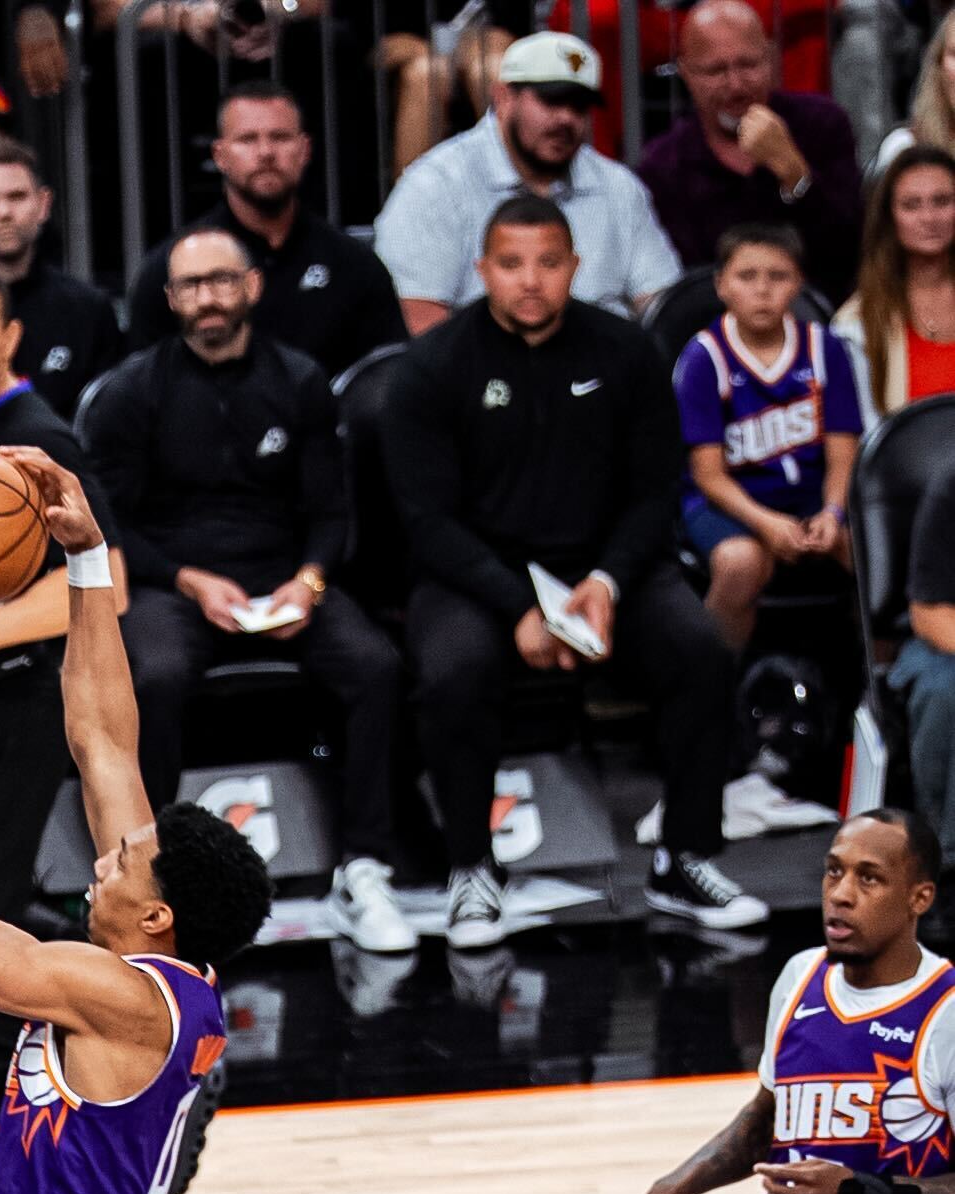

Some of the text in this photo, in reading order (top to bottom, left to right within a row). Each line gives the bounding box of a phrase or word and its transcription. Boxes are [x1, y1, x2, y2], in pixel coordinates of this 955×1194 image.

[725, 398, 818, 466] SUNS
[869, 1021, 915, 1044] PayPal
[774, 1081, 874, 1142] UNS
